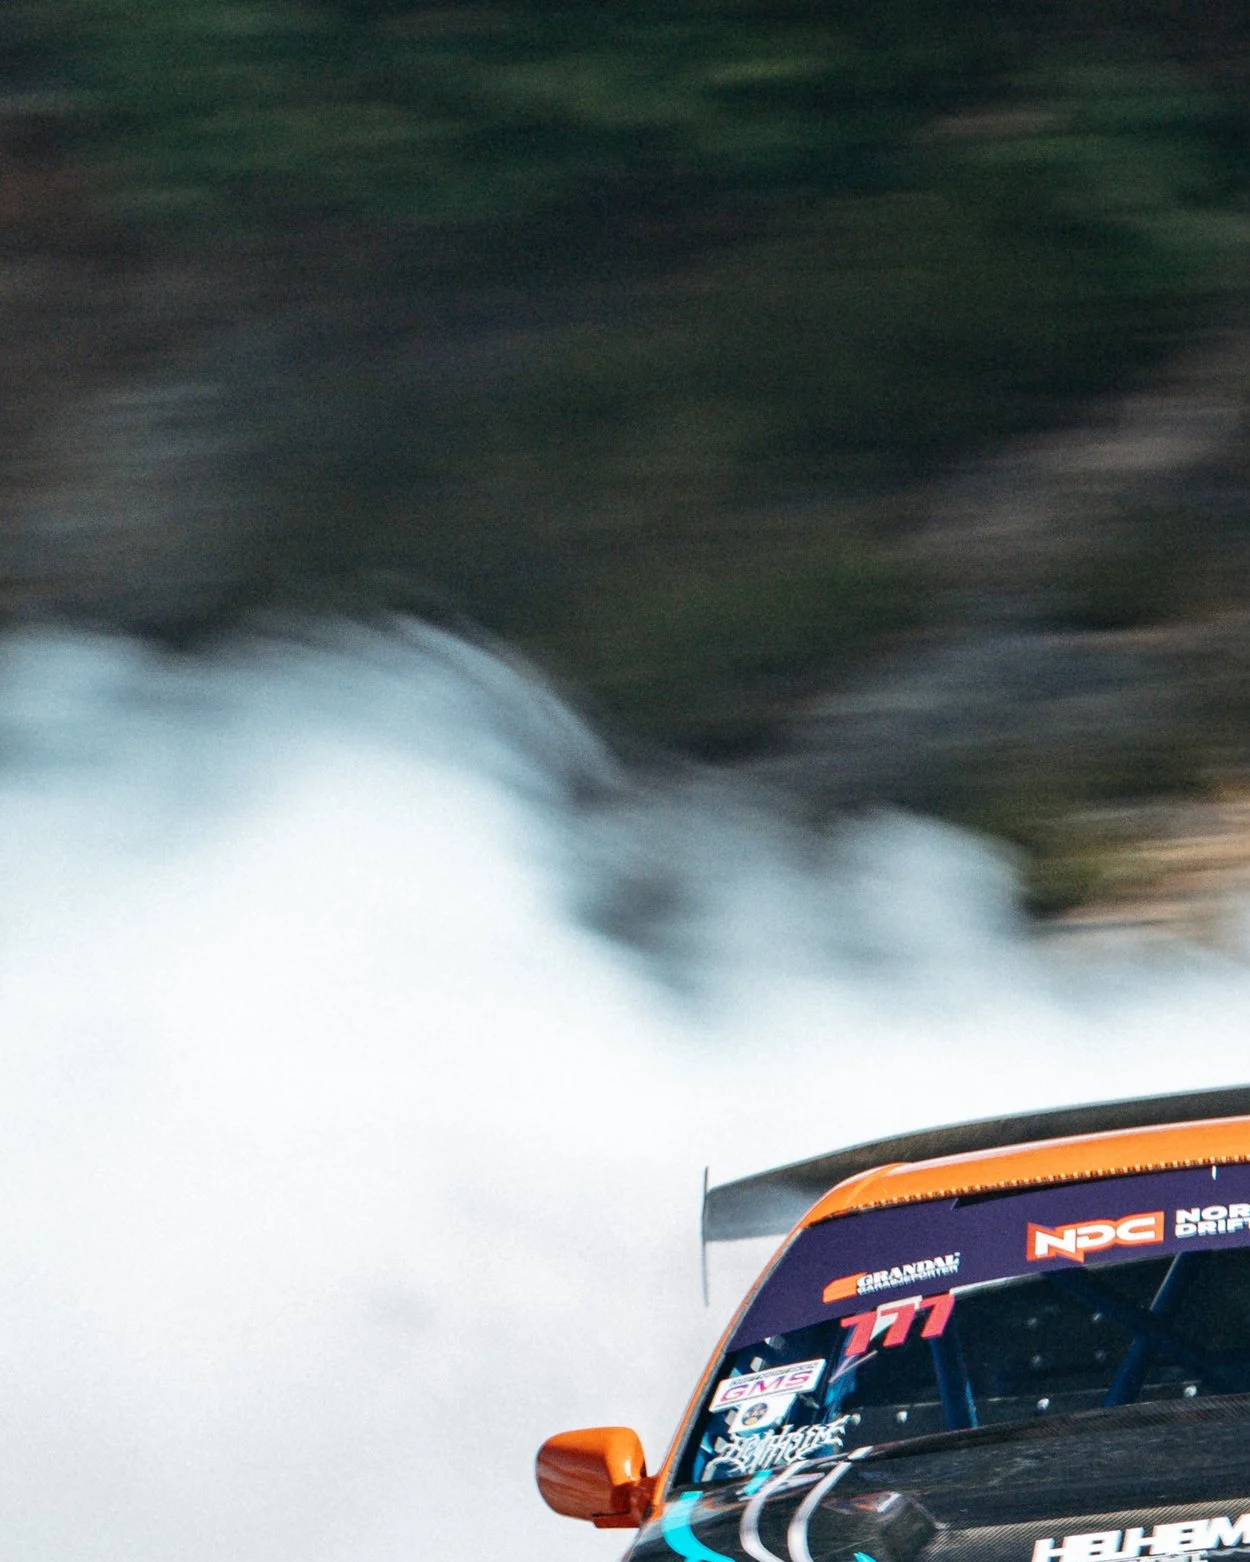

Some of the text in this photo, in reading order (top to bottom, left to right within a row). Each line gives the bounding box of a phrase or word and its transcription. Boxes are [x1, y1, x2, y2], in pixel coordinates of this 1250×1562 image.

[1034, 1216, 1156, 1258] NDC
[840, 1294, 955, 1358] 777
[719, 1369, 814, 1403] GMS
